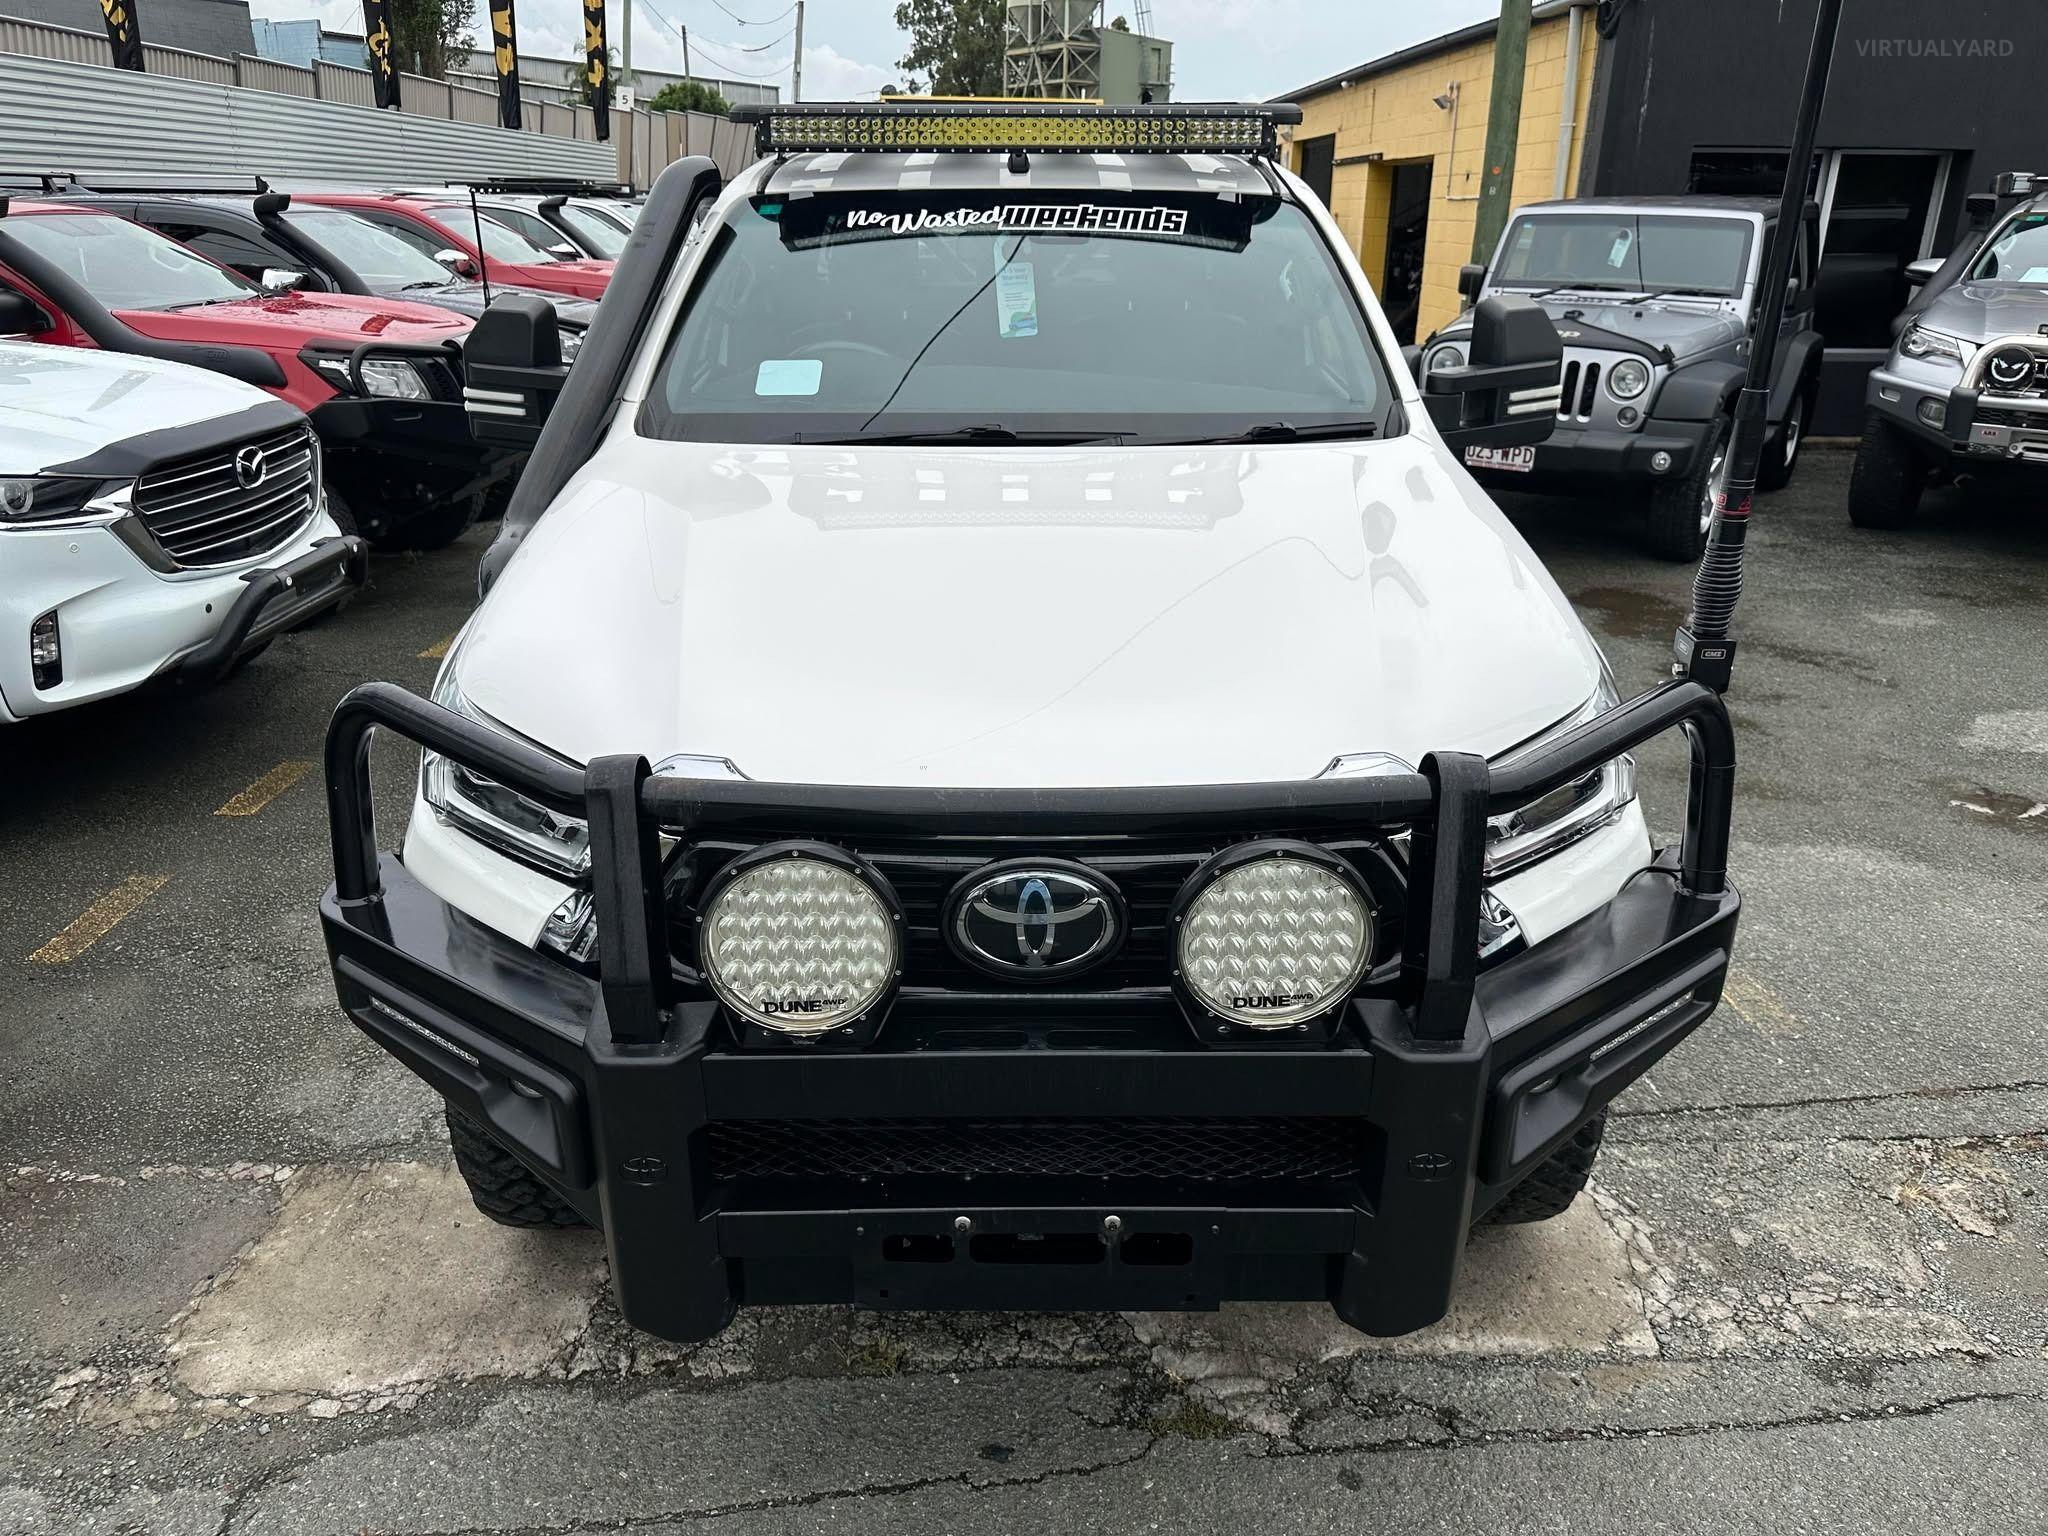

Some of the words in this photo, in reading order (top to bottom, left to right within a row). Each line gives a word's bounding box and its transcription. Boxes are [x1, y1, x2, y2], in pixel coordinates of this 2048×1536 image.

[621, 94, 631, 105] 5
[884, 206, 1001, 234] Wasted
[998, 204, 1188, 236] weekends
[763, 1000, 822, 1013] DUNE
[1233, 995, 1290, 1008] DUNE
